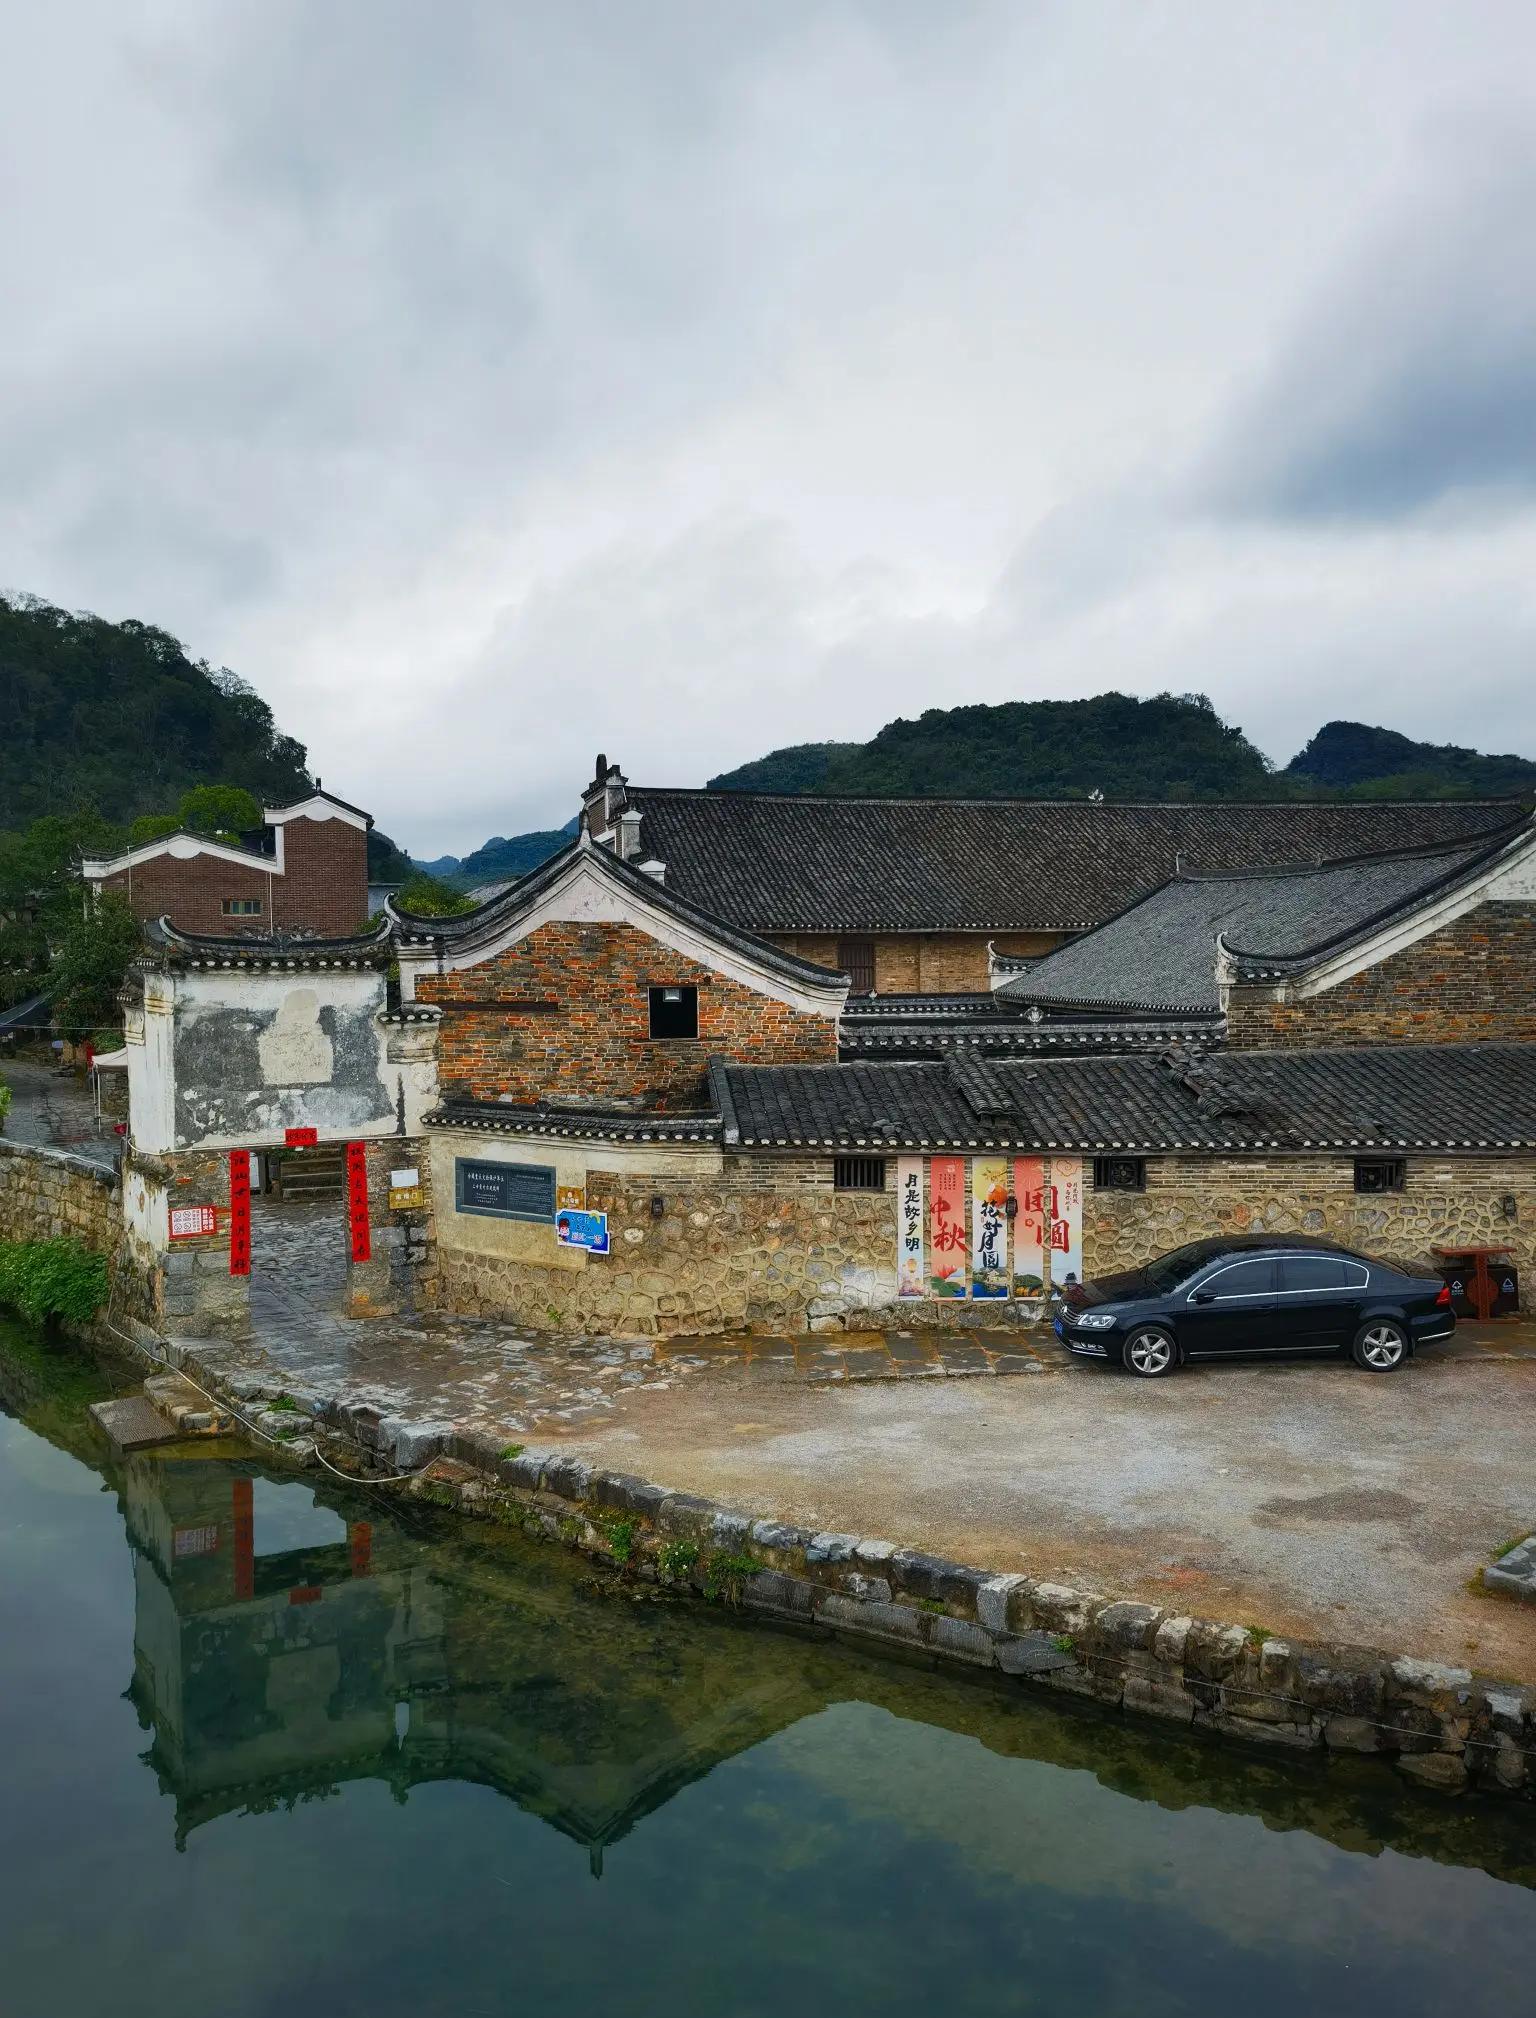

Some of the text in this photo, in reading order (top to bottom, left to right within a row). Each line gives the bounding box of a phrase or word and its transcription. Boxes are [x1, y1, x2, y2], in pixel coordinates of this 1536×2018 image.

[904, 1173, 920, 1252] 月是故乡明
[930, 1195, 969, 1253] 中秋
[977, 1199, 1003, 1269] 花好月圆
